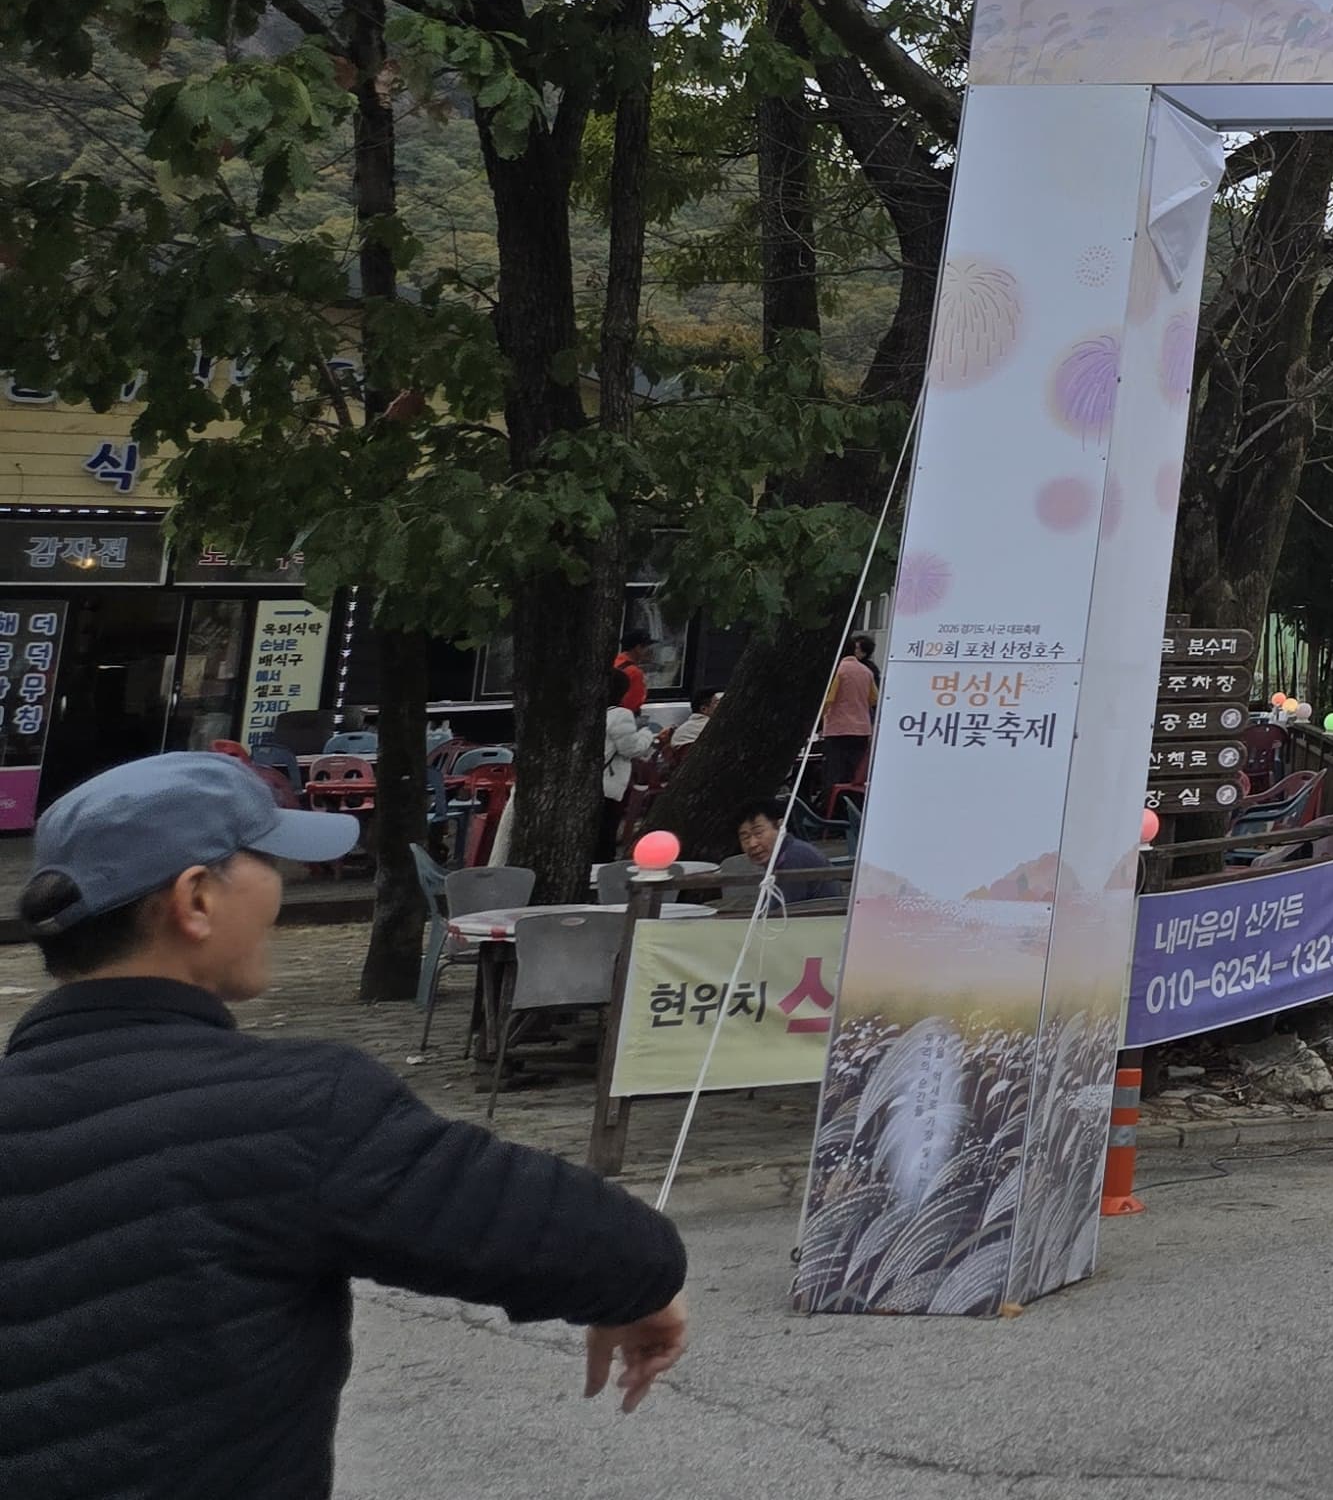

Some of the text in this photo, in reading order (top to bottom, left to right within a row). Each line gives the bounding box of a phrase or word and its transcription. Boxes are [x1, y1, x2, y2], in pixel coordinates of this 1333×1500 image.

[25, 536, 128, 568] 감자전
[262, 622, 322, 636] 옥외식탁
[938, 623, 960, 634] 2026
[961, 623, 985, 635] 경기도
[1007, 623, 1041, 636] 대표축제
[260, 638, 298, 651] 손님은
[907, 639, 1065, 660] 제29회 포천 산정호수
[1187, 637, 1238, 656] 분수대
[258, 653, 304, 667] 배식구
[13, 613, 57, 733] 더덕무침
[931, 671, 1026, 707] 명성산
[1158, 674, 1236, 693] 주차장
[899, 711, 1057, 748] 억새꽃축제
[1160, 711, 1207, 731] 공원
[1155, 893, 1304, 954] 내마음의 산가든
[650, 980, 768, 1028] 현위치
